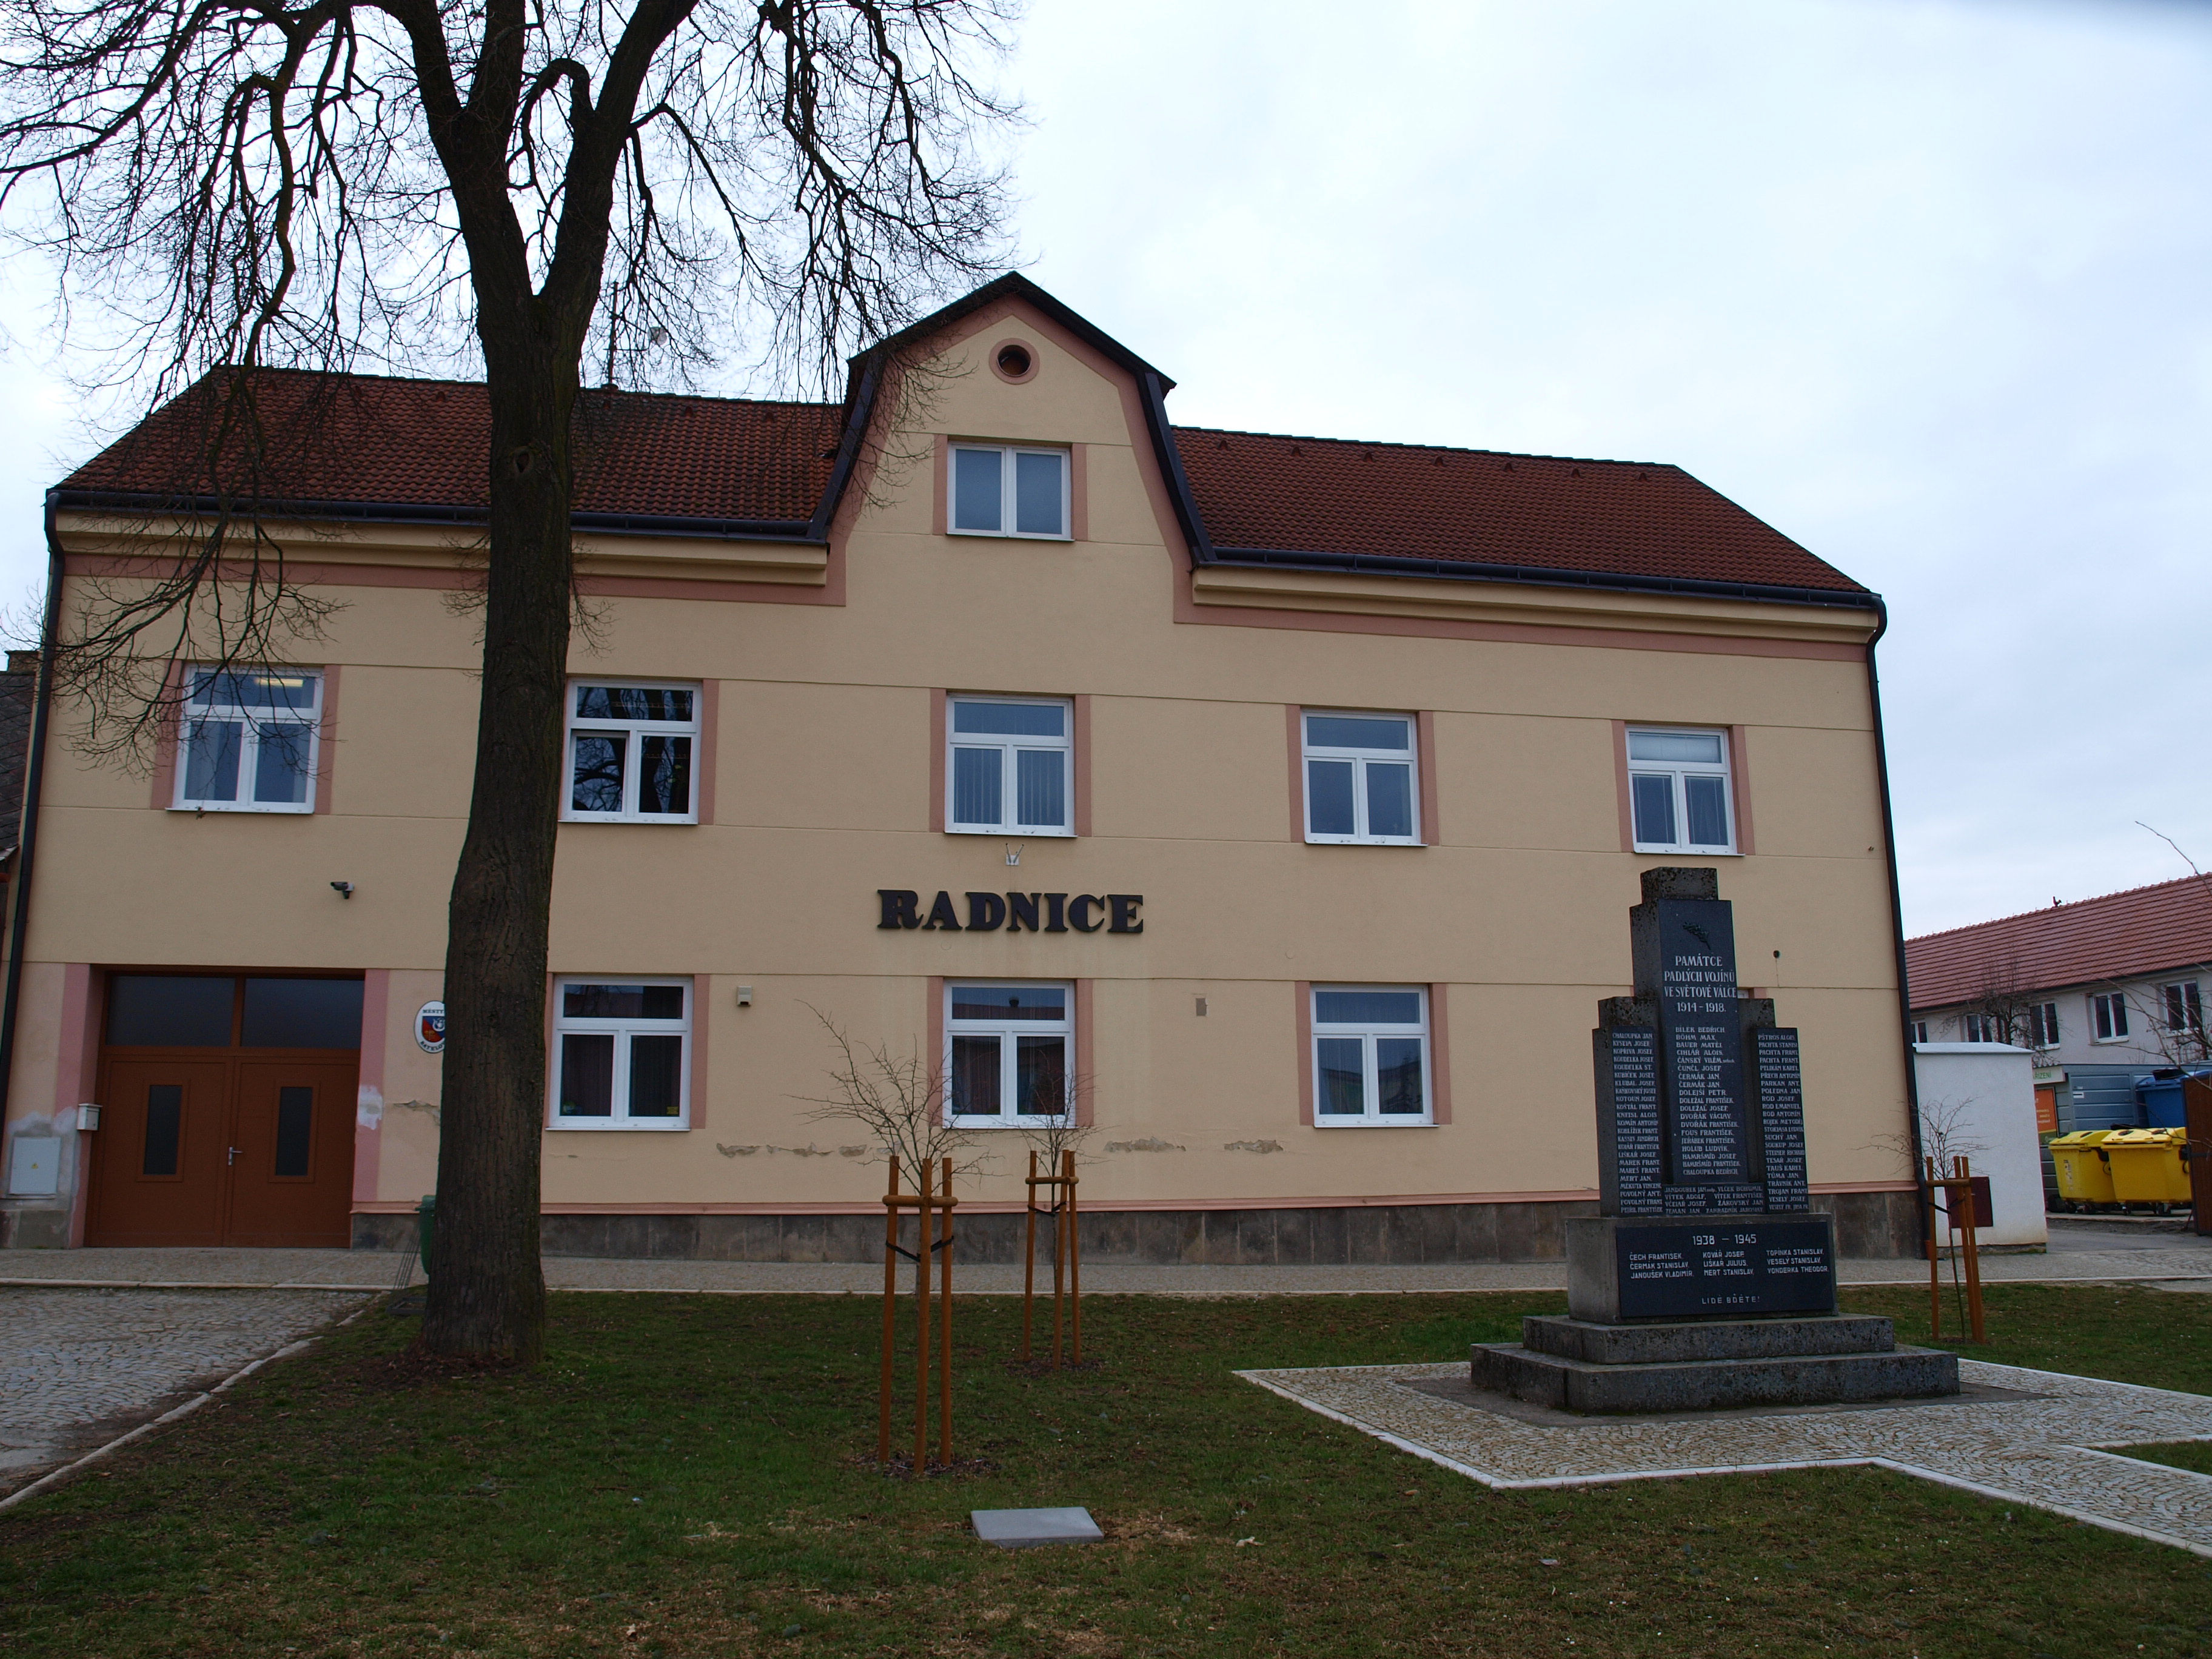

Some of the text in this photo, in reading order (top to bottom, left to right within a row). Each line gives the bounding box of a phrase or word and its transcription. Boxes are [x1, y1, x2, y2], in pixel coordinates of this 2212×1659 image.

[877, 890, 1144, 933] RADNICE
[1675, 953, 1723, 967] PAMÁTCE
[1664, 968, 1734, 982] PADLÝCH VOJÍNŮ
[1664, 985, 1737, 997] VE SVĚTOVÉ VÁLCE
[1677, 1002, 1697, 1012] 1914
[1706, 1003, 1726, 1012] 1918.
[1693, 1235, 1715, 1245] 1938
[1735, 1234, 1757, 1244] 1945
[1630, 1261, 1655, 1270] ČERMÁK
